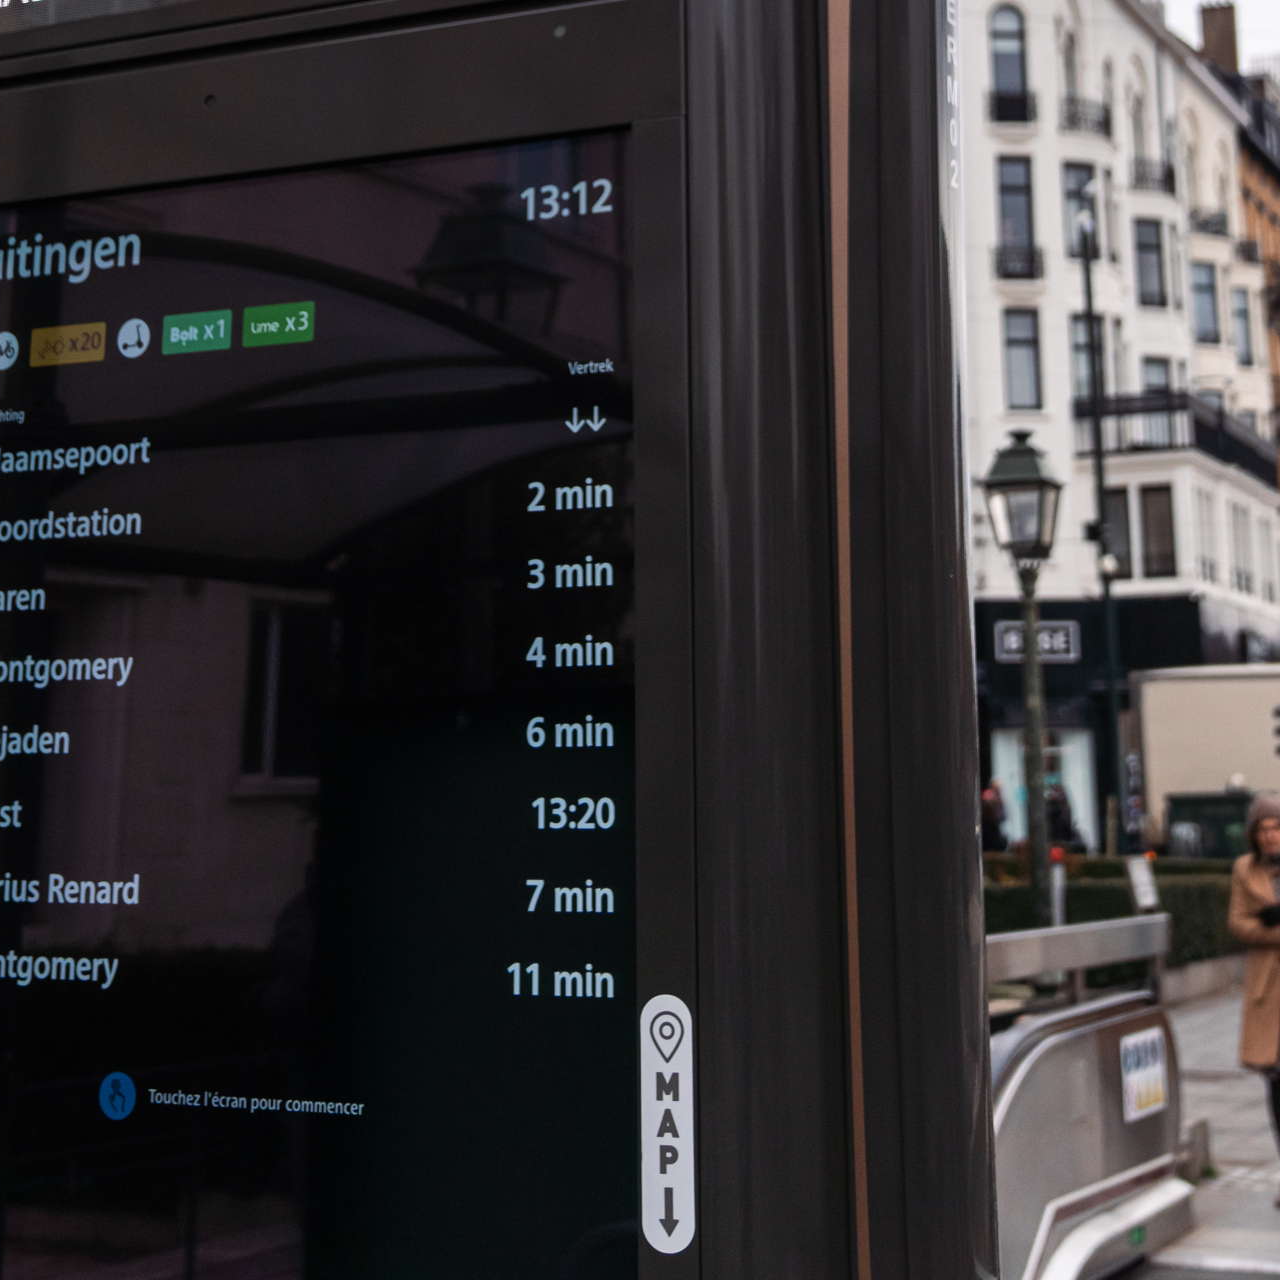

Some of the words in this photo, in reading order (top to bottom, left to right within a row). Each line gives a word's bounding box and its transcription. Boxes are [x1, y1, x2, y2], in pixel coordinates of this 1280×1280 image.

[521, 179, 612, 220] 13:12
[68, 331, 102, 353] x20
[169, 325, 199, 346] Bolt
[567, 358, 614, 375] Vertrek
[528, 482, 545, 511] 2
[556, 478, 612, 510] min
[528, 559, 544, 589] 3
[556, 556, 612, 587] min
[526, 637, 546, 667] 4
[556, 635, 613, 667] min
[527, 717, 545, 747] 6
[555, 715, 613, 747] min
[532, 797, 615, 829] 13:20
[48, 874, 139, 904] Renard
[526, 880, 544, 911] 7
[555, 880, 613, 912] min
[508, 963, 539, 995] 11
[554, 964, 613, 998] min
[148, 1088, 201, 1107] Touchez
[203, 1091, 247, 1109] l'écran
[250, 1097, 283, 1113] pour
[285, 1099, 365, 1116] commencer
[656, 1072, 679, 1174] MAP
